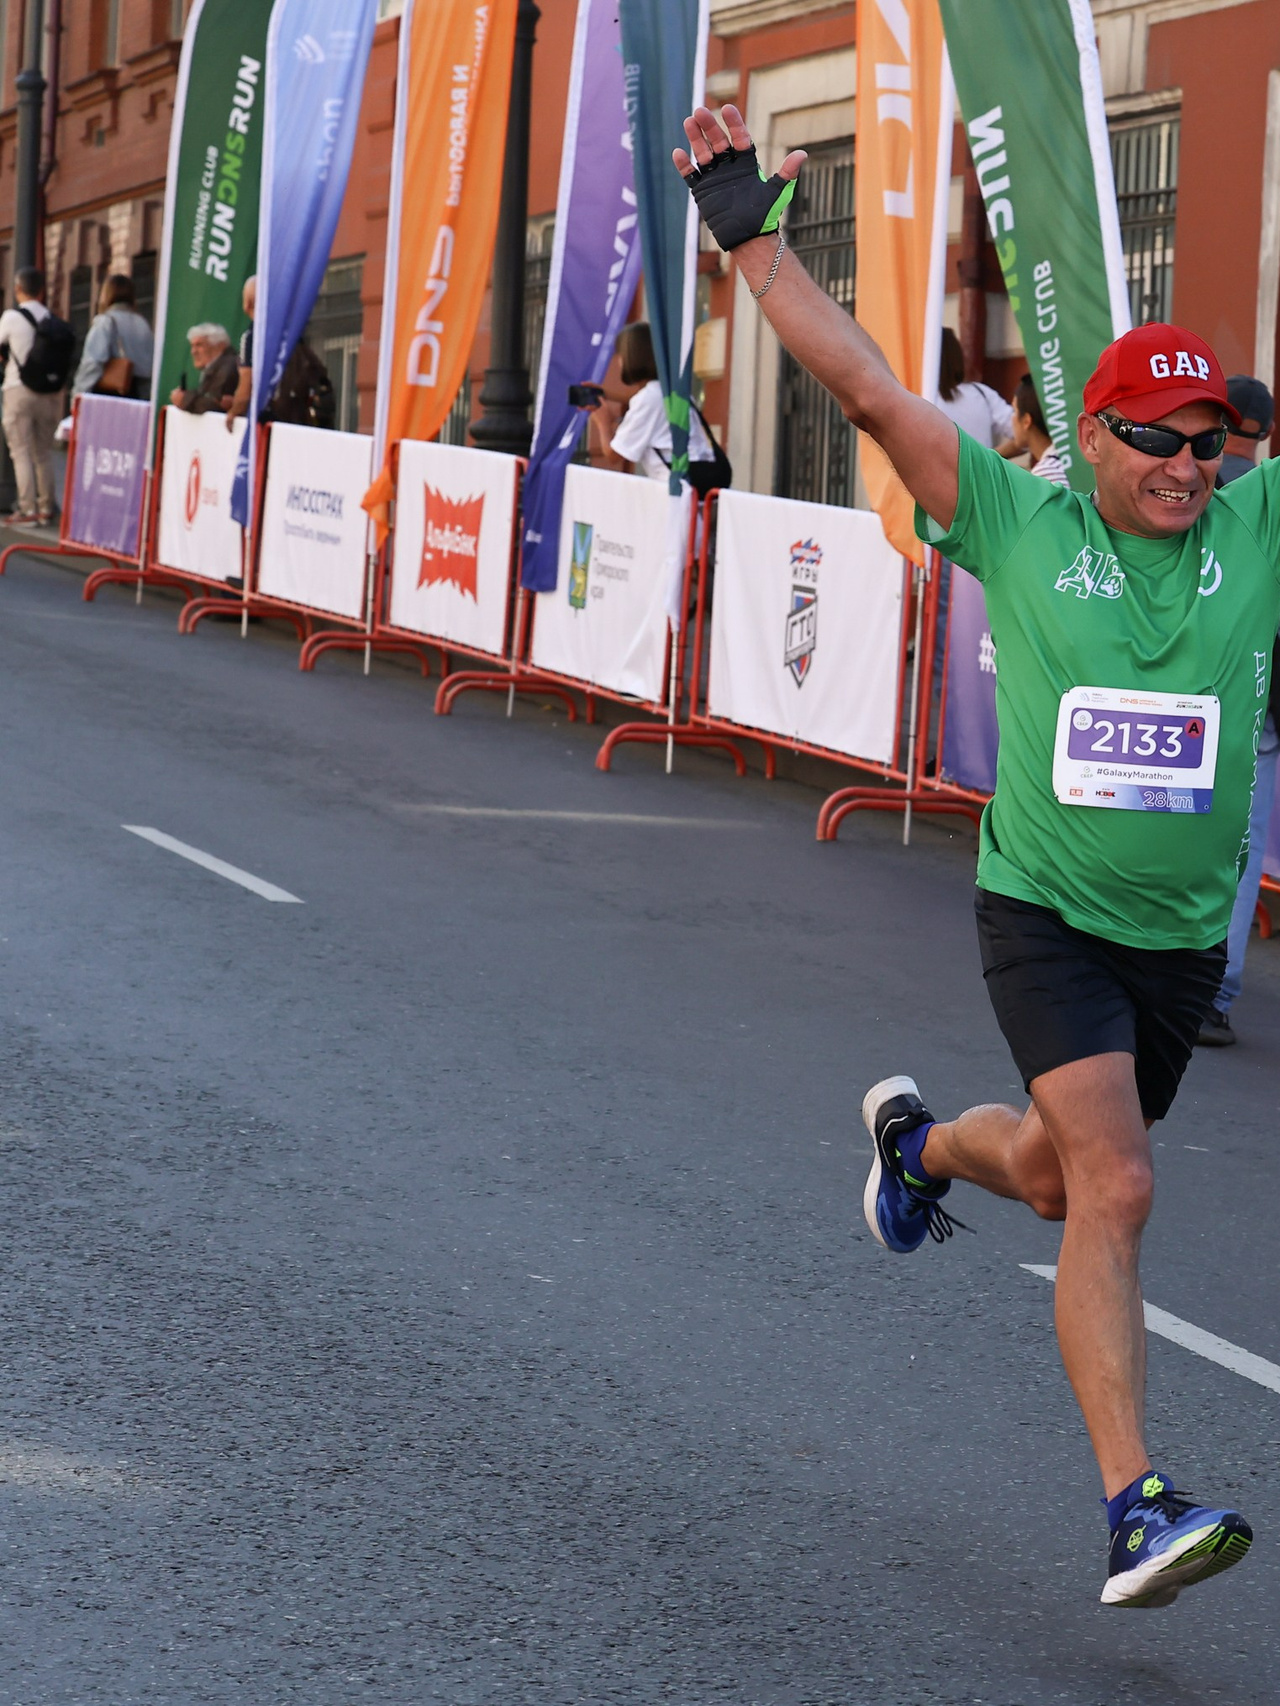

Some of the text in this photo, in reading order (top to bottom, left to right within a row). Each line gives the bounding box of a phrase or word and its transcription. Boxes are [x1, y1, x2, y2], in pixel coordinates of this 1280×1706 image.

[205, 55, 262, 282] RUNDNSRUN
[190, 146, 219, 270] RUNNING CLUB
[1149, 351, 1210, 381] GAP
[1090, 720, 1183, 758] 2133
[1188, 722, 1200, 734] A
[1097, 768, 1174, 781] #GalaxyMarathon
[1142, 790, 1193, 809] 28km
